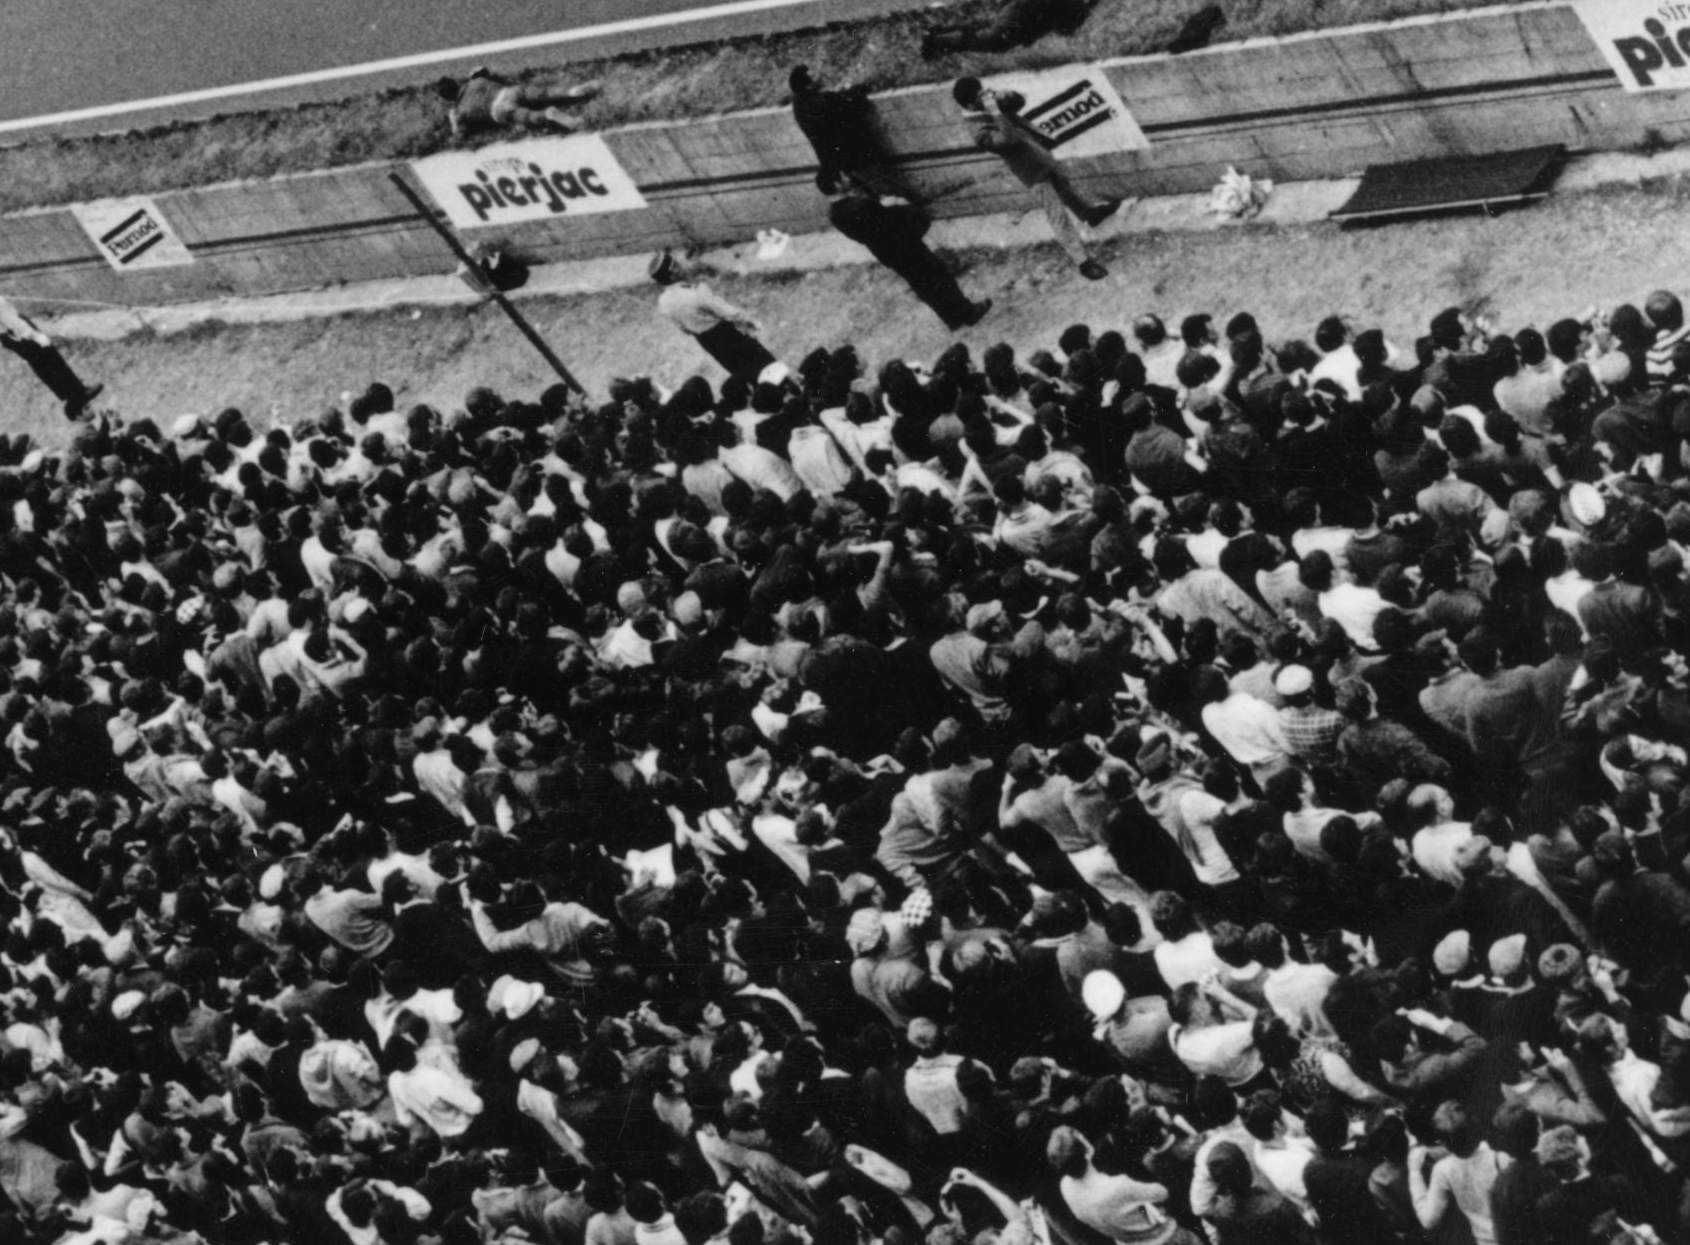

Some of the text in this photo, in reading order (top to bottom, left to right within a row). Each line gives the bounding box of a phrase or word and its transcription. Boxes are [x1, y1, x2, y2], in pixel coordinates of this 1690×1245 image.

[1037, 88, 1104, 133] ernod
[458, 145, 607, 220] pierjac
[110, 218, 158, 254] Pernod
